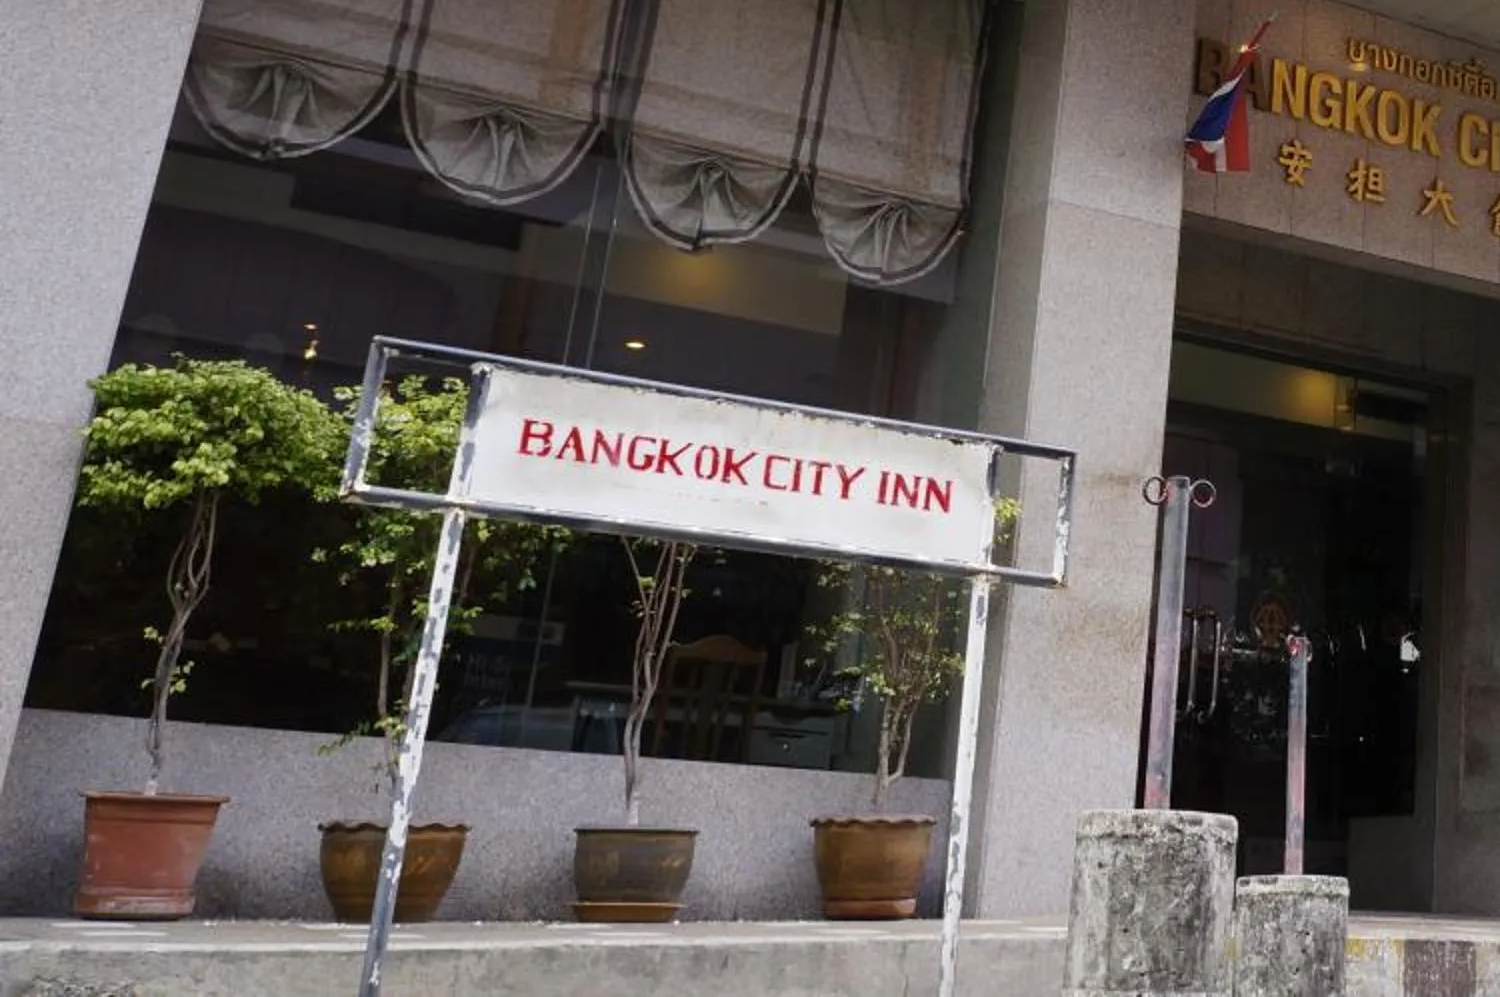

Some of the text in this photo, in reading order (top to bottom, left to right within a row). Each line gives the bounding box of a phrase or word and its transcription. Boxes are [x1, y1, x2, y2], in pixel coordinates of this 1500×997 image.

[1193, 36, 1441, 158] BANGKOK
[517, 418, 955, 514] BANGKOK CITY INN
